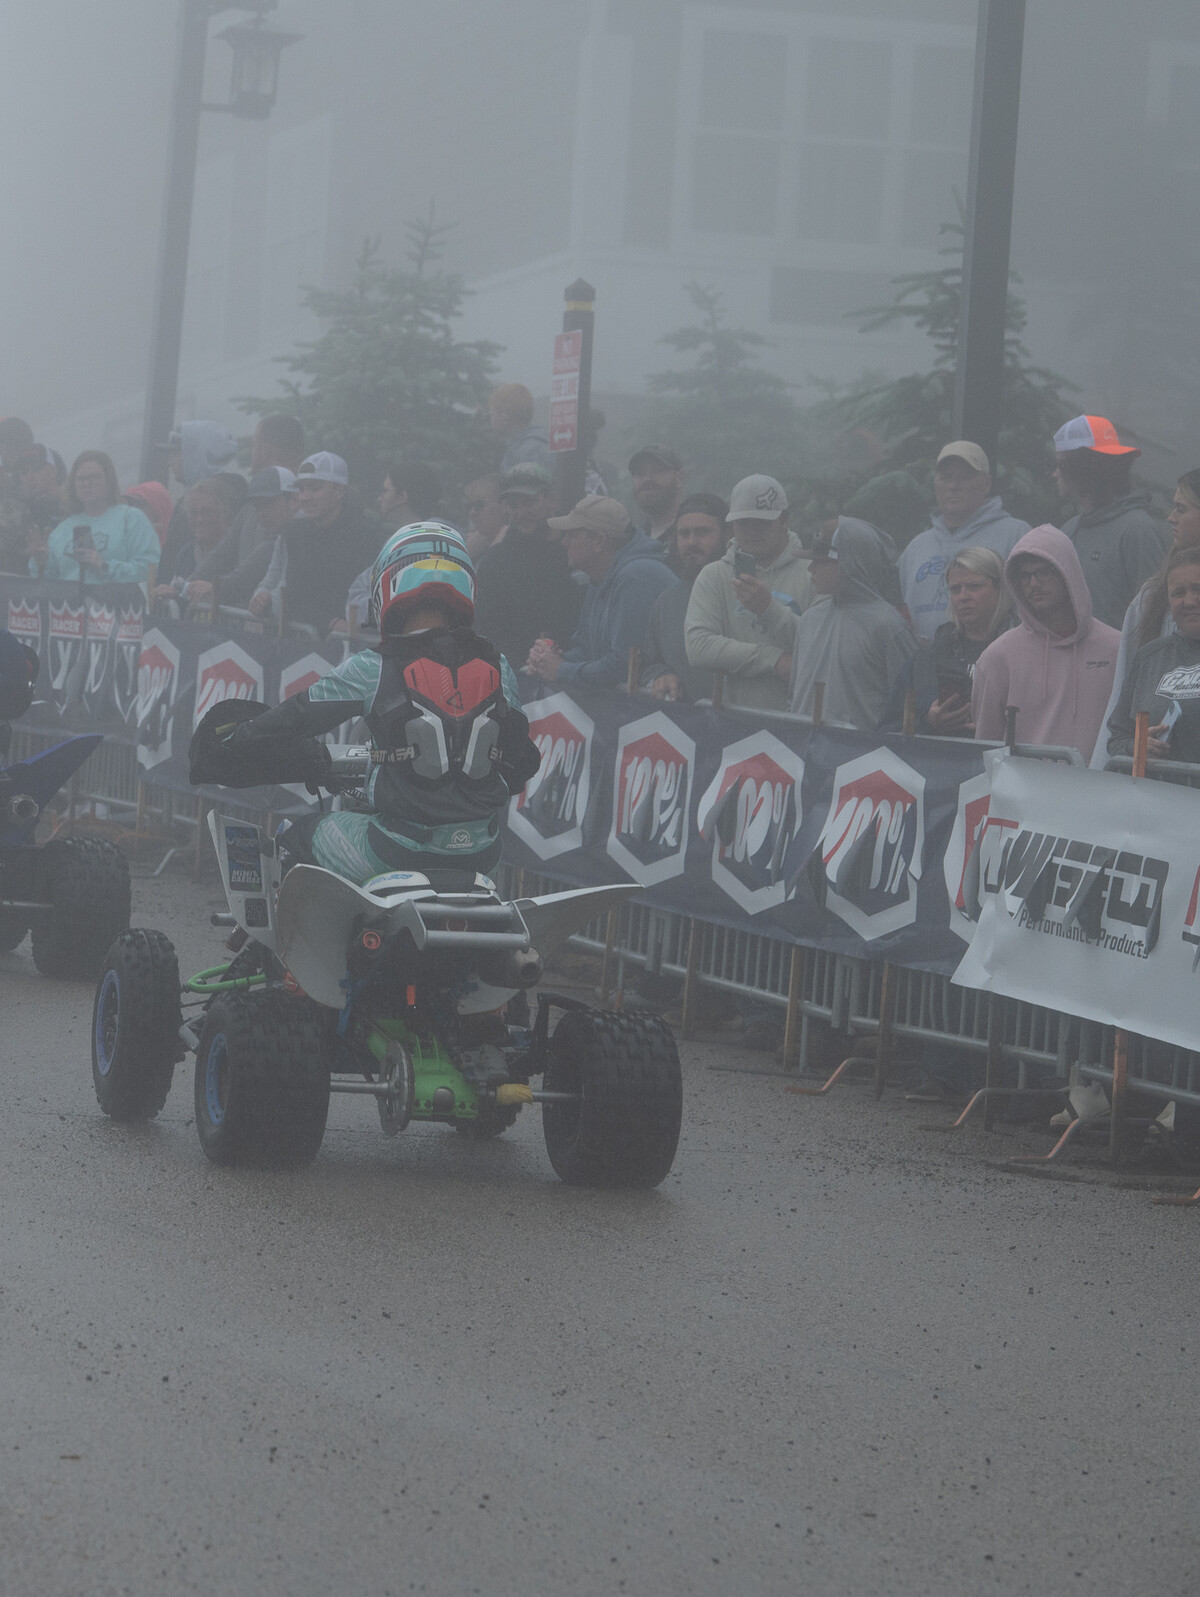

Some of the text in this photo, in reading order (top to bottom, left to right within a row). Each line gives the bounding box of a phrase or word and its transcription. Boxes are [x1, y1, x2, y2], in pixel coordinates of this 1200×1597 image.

[10, 616, 38, 630] RACER
[52, 617, 81, 633] RACER
[1096, 929, 1150, 960] Products
